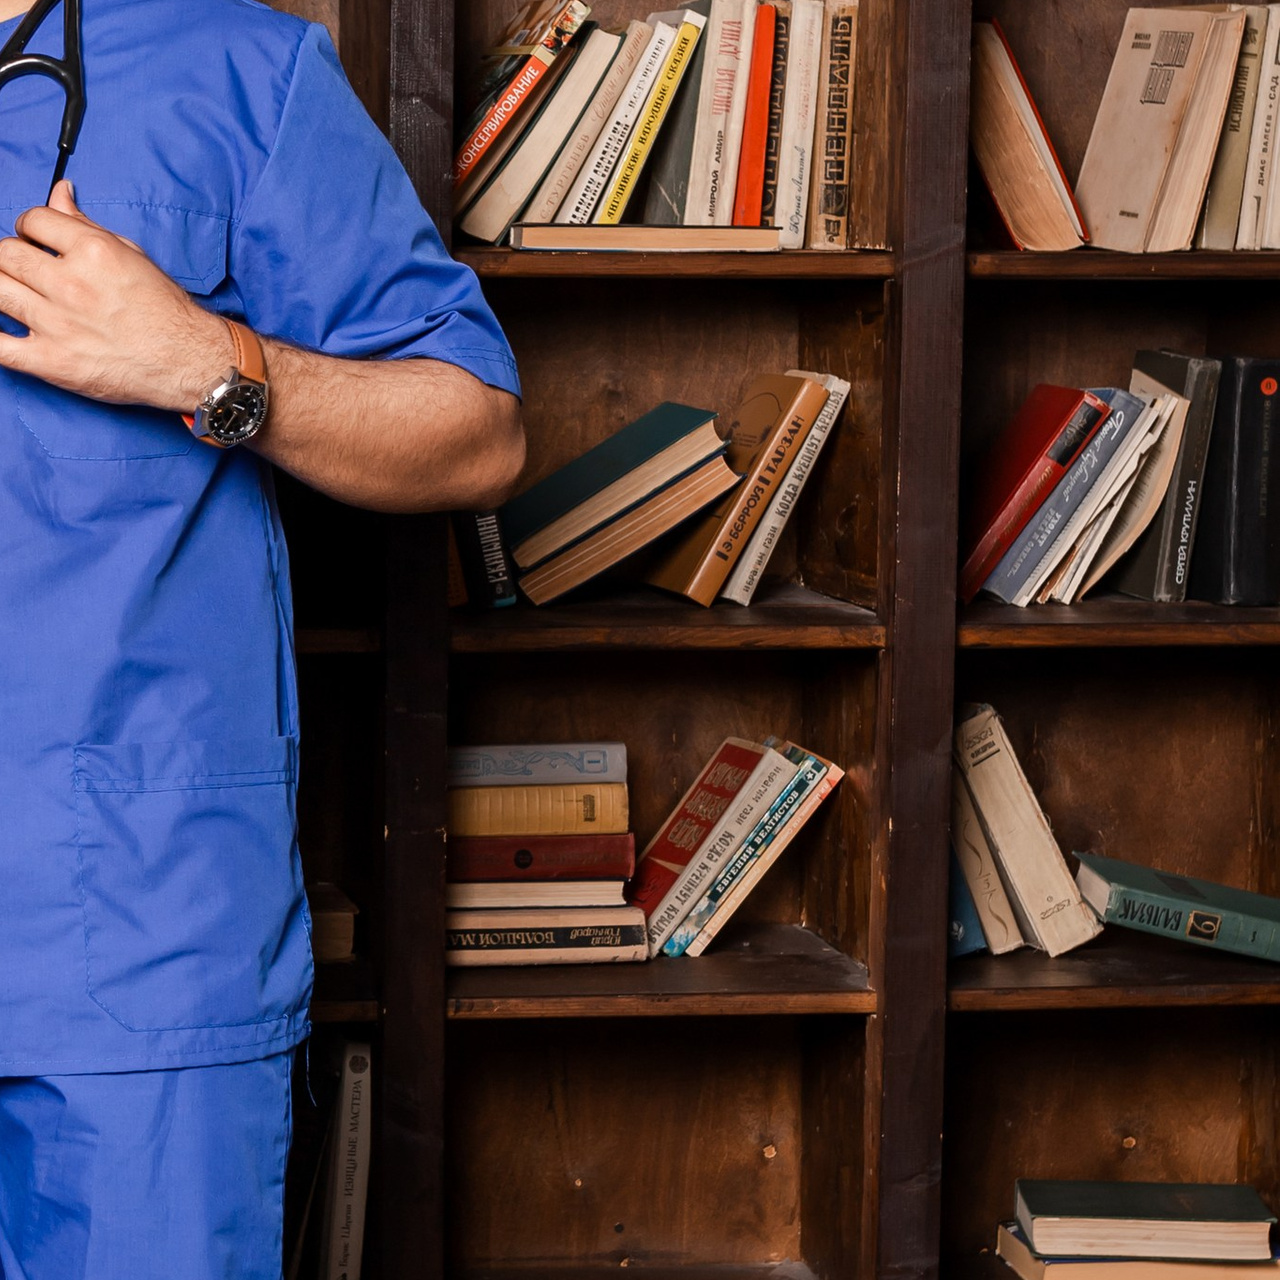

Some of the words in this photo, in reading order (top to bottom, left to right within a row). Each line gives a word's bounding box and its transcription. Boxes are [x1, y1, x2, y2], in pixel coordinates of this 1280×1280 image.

[621, 24, 647, 63] дети
[719, 17, 743, 61] ДУША
[710, 66, 736, 117] ЧИСТАЯ
[820, 17, 852, 215] СТЕНДАЛЬ
[1229, 64, 1249, 133] И.С.НИКИТИН
[606, 148, 642, 220] АНГЛИЙСКИЕ
[636, 84, 670, 147] НАРОДНЫЕ
[664, 37, 690, 82] СКАЗКИ
[713, 129, 724, 163] АМИР
[1256, 158, 1266, 186] ДИАС
[1268, 75, 1279, 101] САД
[813, 388, 844, 433] КРЫЛЬЯ
[764, 413, 805, 476] ТАРЗАН
[1179, 478, 1197, 544] КРУТИЛИН
[1175, 544, 1187, 584] СЕРГЕЙ
[713, 844, 756, 893] ЕВГЕНИЙ
[752, 788, 800, 845] ВЕЛТИСТОВ
[478, 930, 556, 948] БОЛЬШОЙ
[1116, 896, 1183, 934] БАЛЬЗАК
[348, 1078, 363, 1133] МАСТЕРА
[342, 1135, 359, 1197] ИЗЯЩНЫЕ
